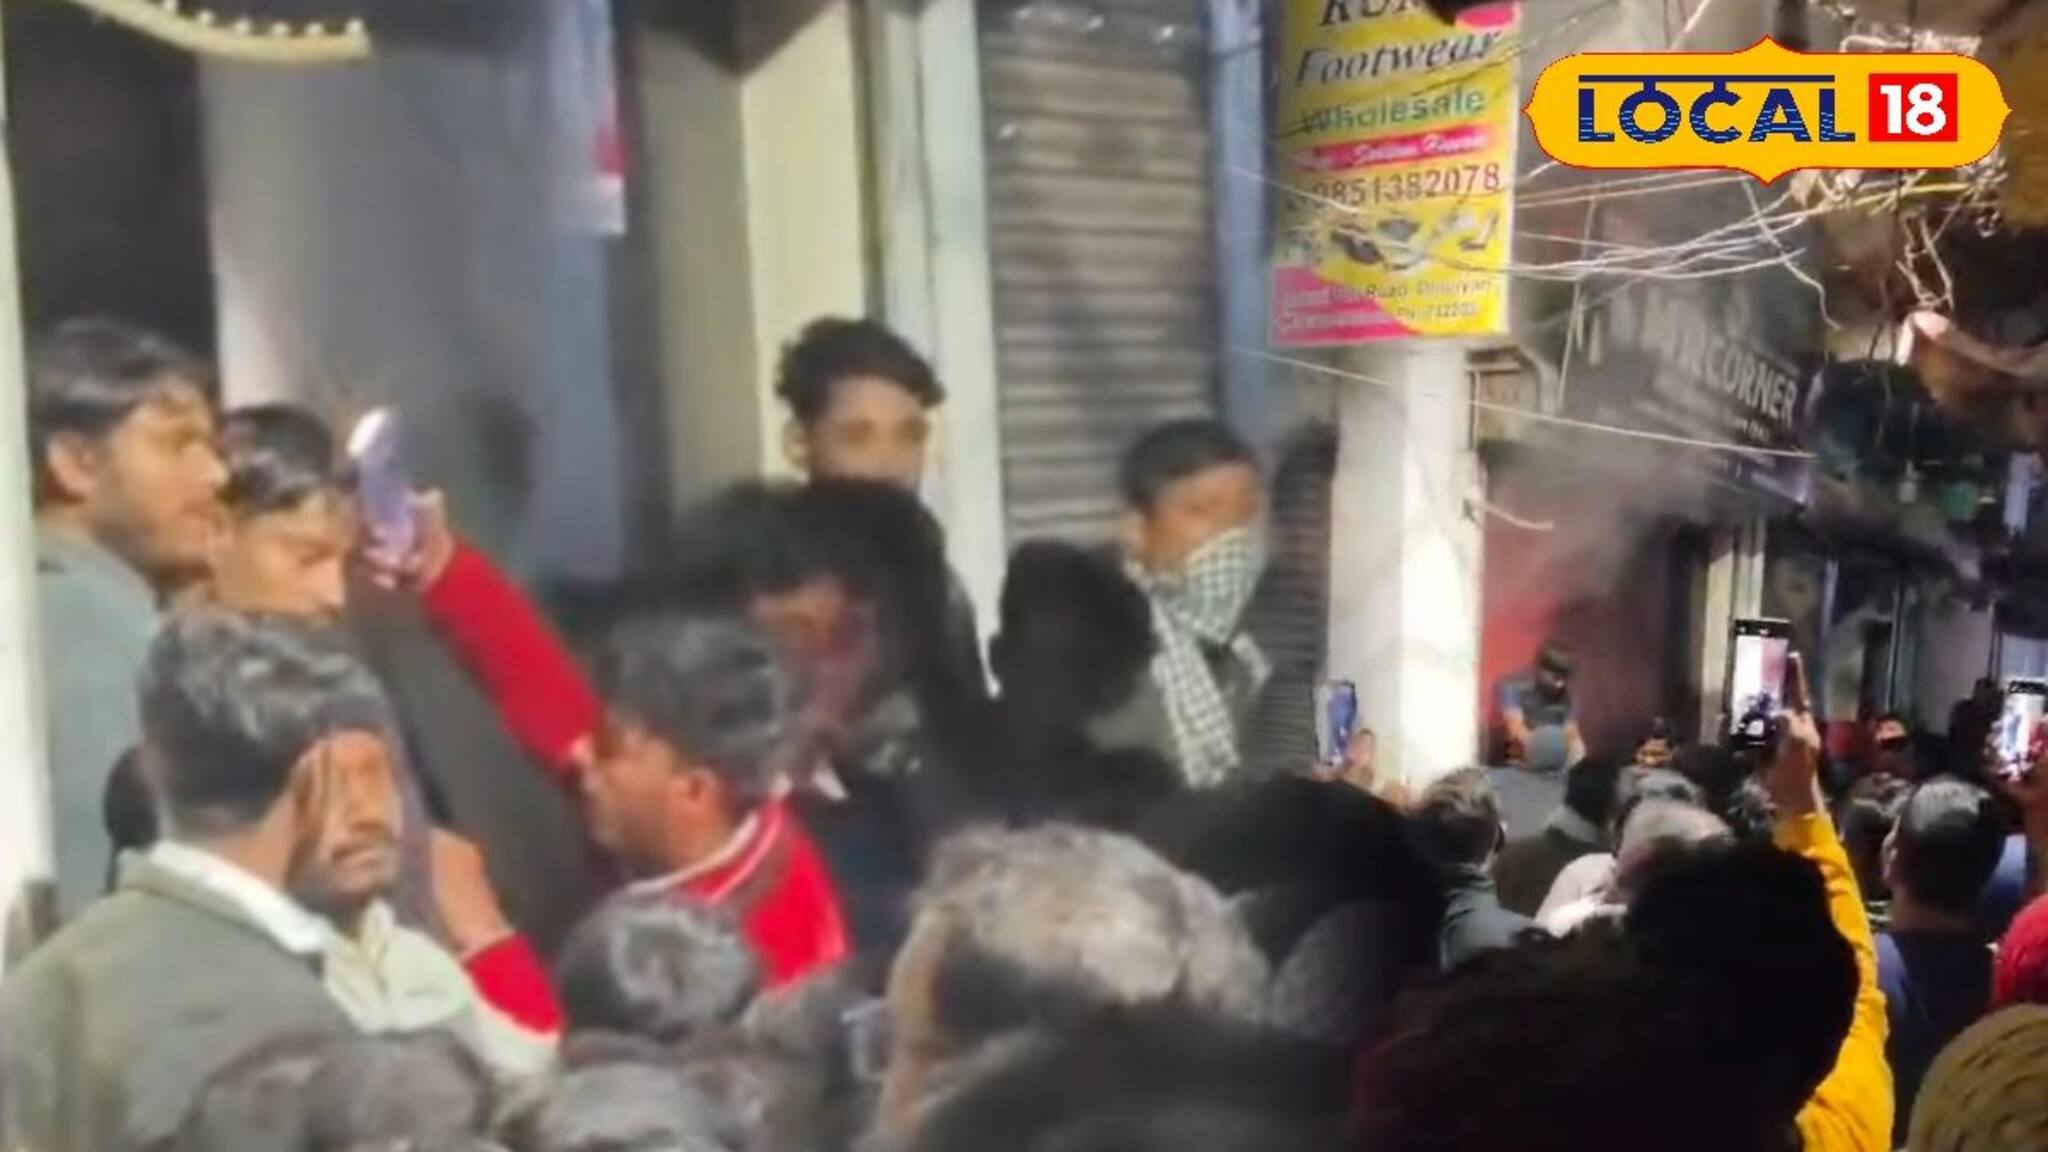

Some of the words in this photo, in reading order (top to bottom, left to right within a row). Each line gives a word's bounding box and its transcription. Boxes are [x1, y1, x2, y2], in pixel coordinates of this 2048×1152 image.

[1295, 29, 1502, 88] Footwear
[1301, 87, 1486, 135] Wholesale
[1706, 338, 1798, 428] CORNER
